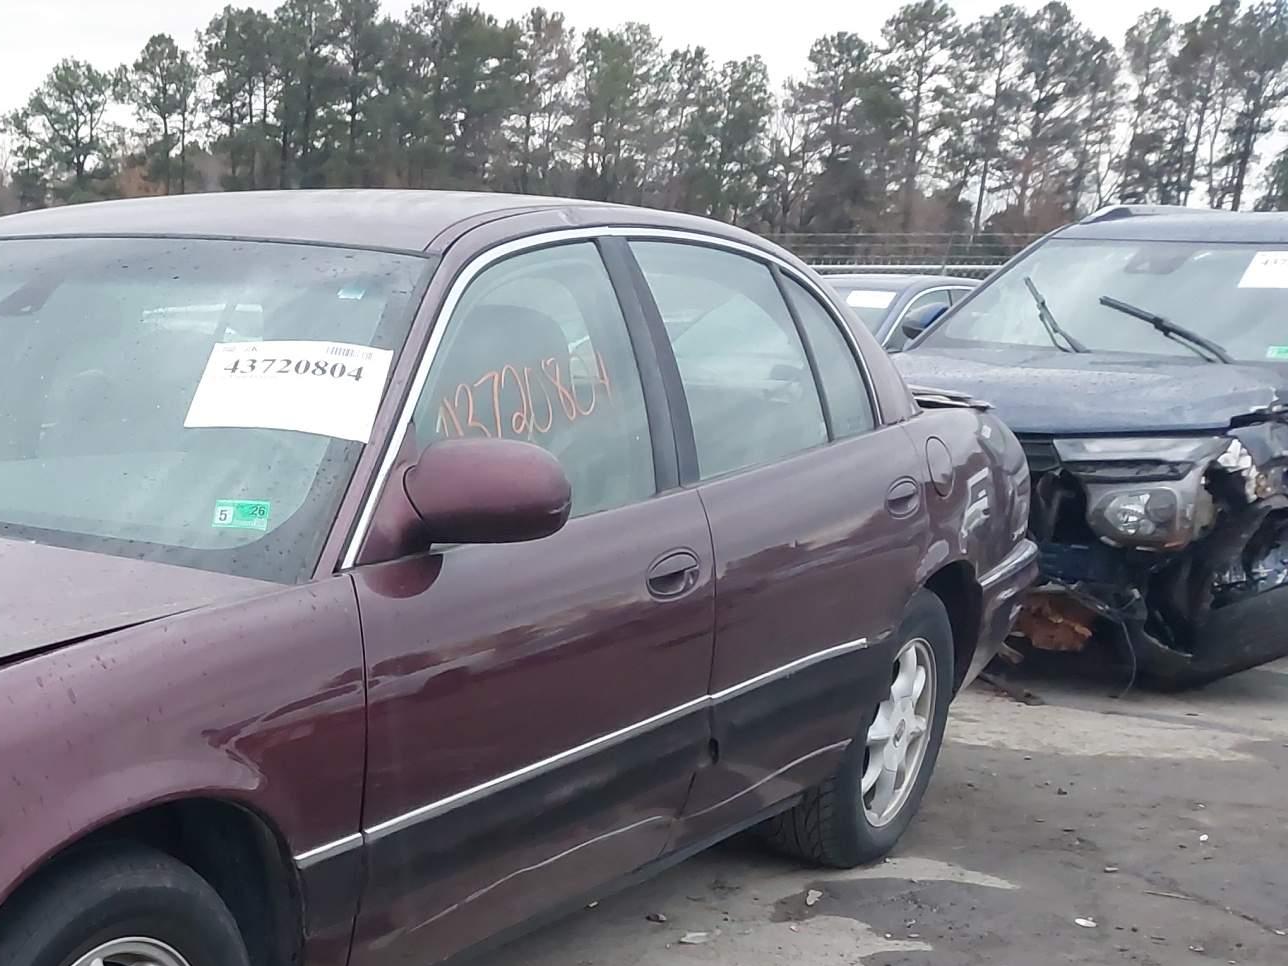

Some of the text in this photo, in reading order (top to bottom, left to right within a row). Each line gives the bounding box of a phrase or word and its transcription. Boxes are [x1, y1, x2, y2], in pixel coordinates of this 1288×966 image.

[223, 358, 364, 382] 43720804
[218, 503, 266, 522] 5 26
